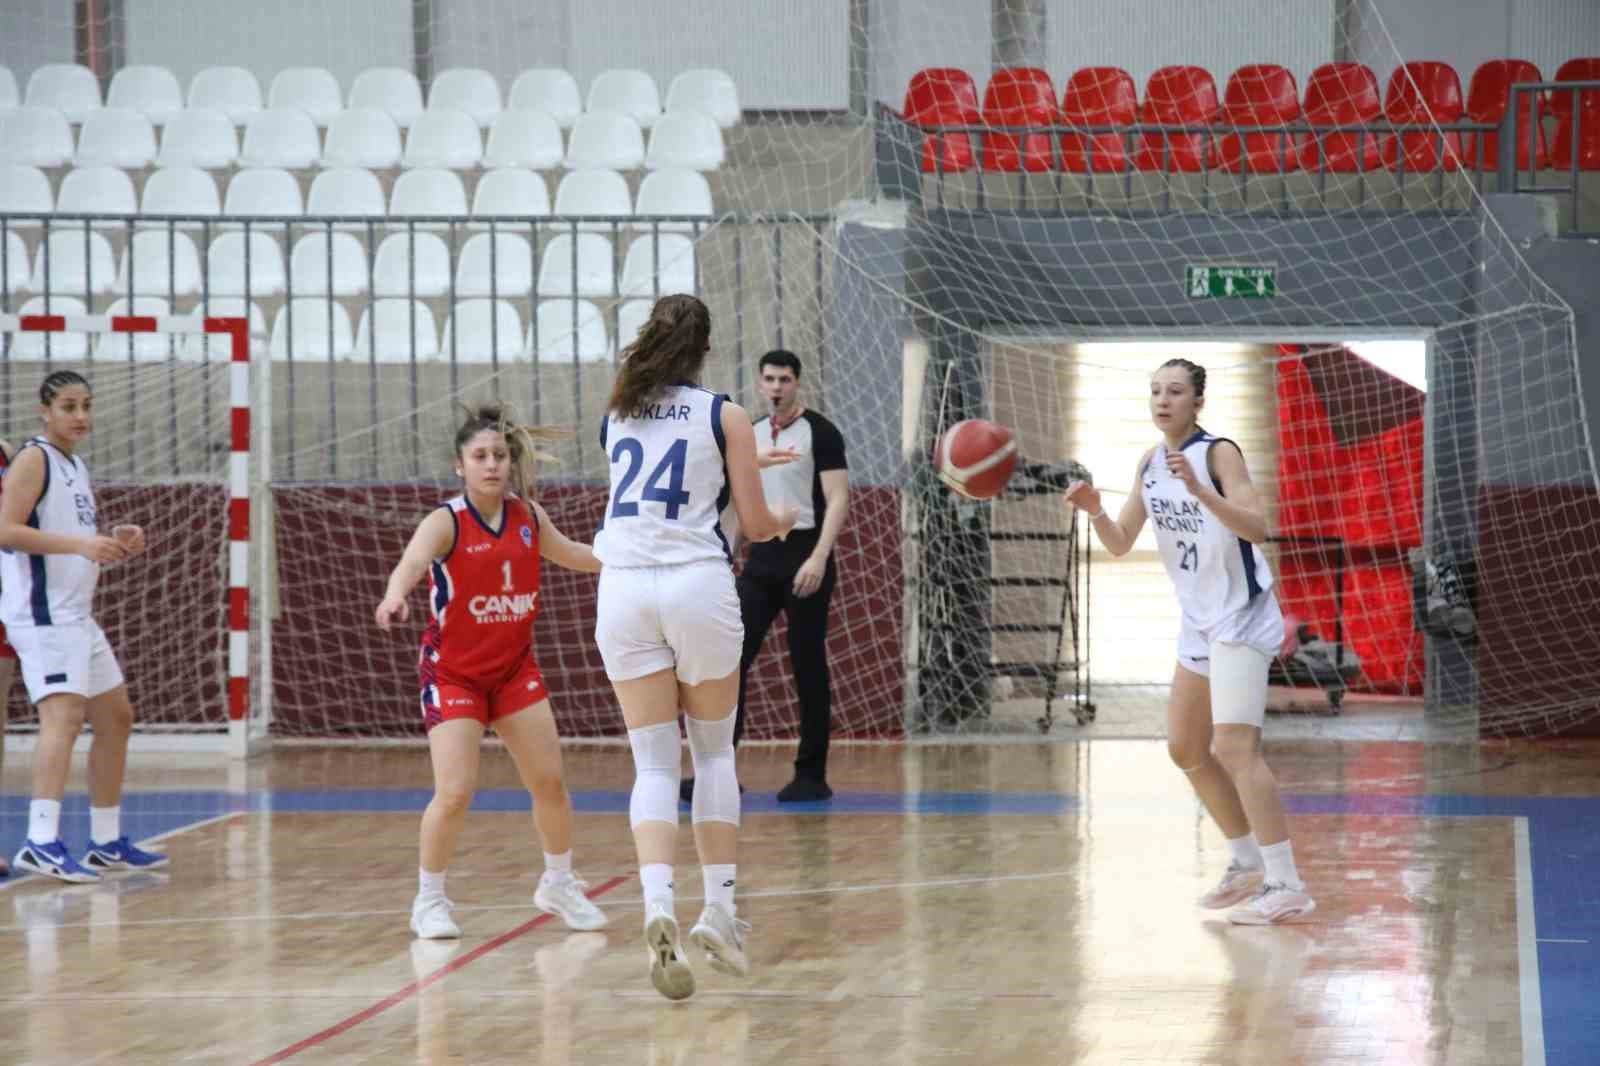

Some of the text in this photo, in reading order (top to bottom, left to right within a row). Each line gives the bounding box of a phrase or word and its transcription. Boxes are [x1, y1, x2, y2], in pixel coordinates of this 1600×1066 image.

[610, 437, 690, 520] 24
[1150, 498, 1202, 516] EMLAK
[1176, 540, 1198, 572] 21
[502, 560, 514, 591] 1
